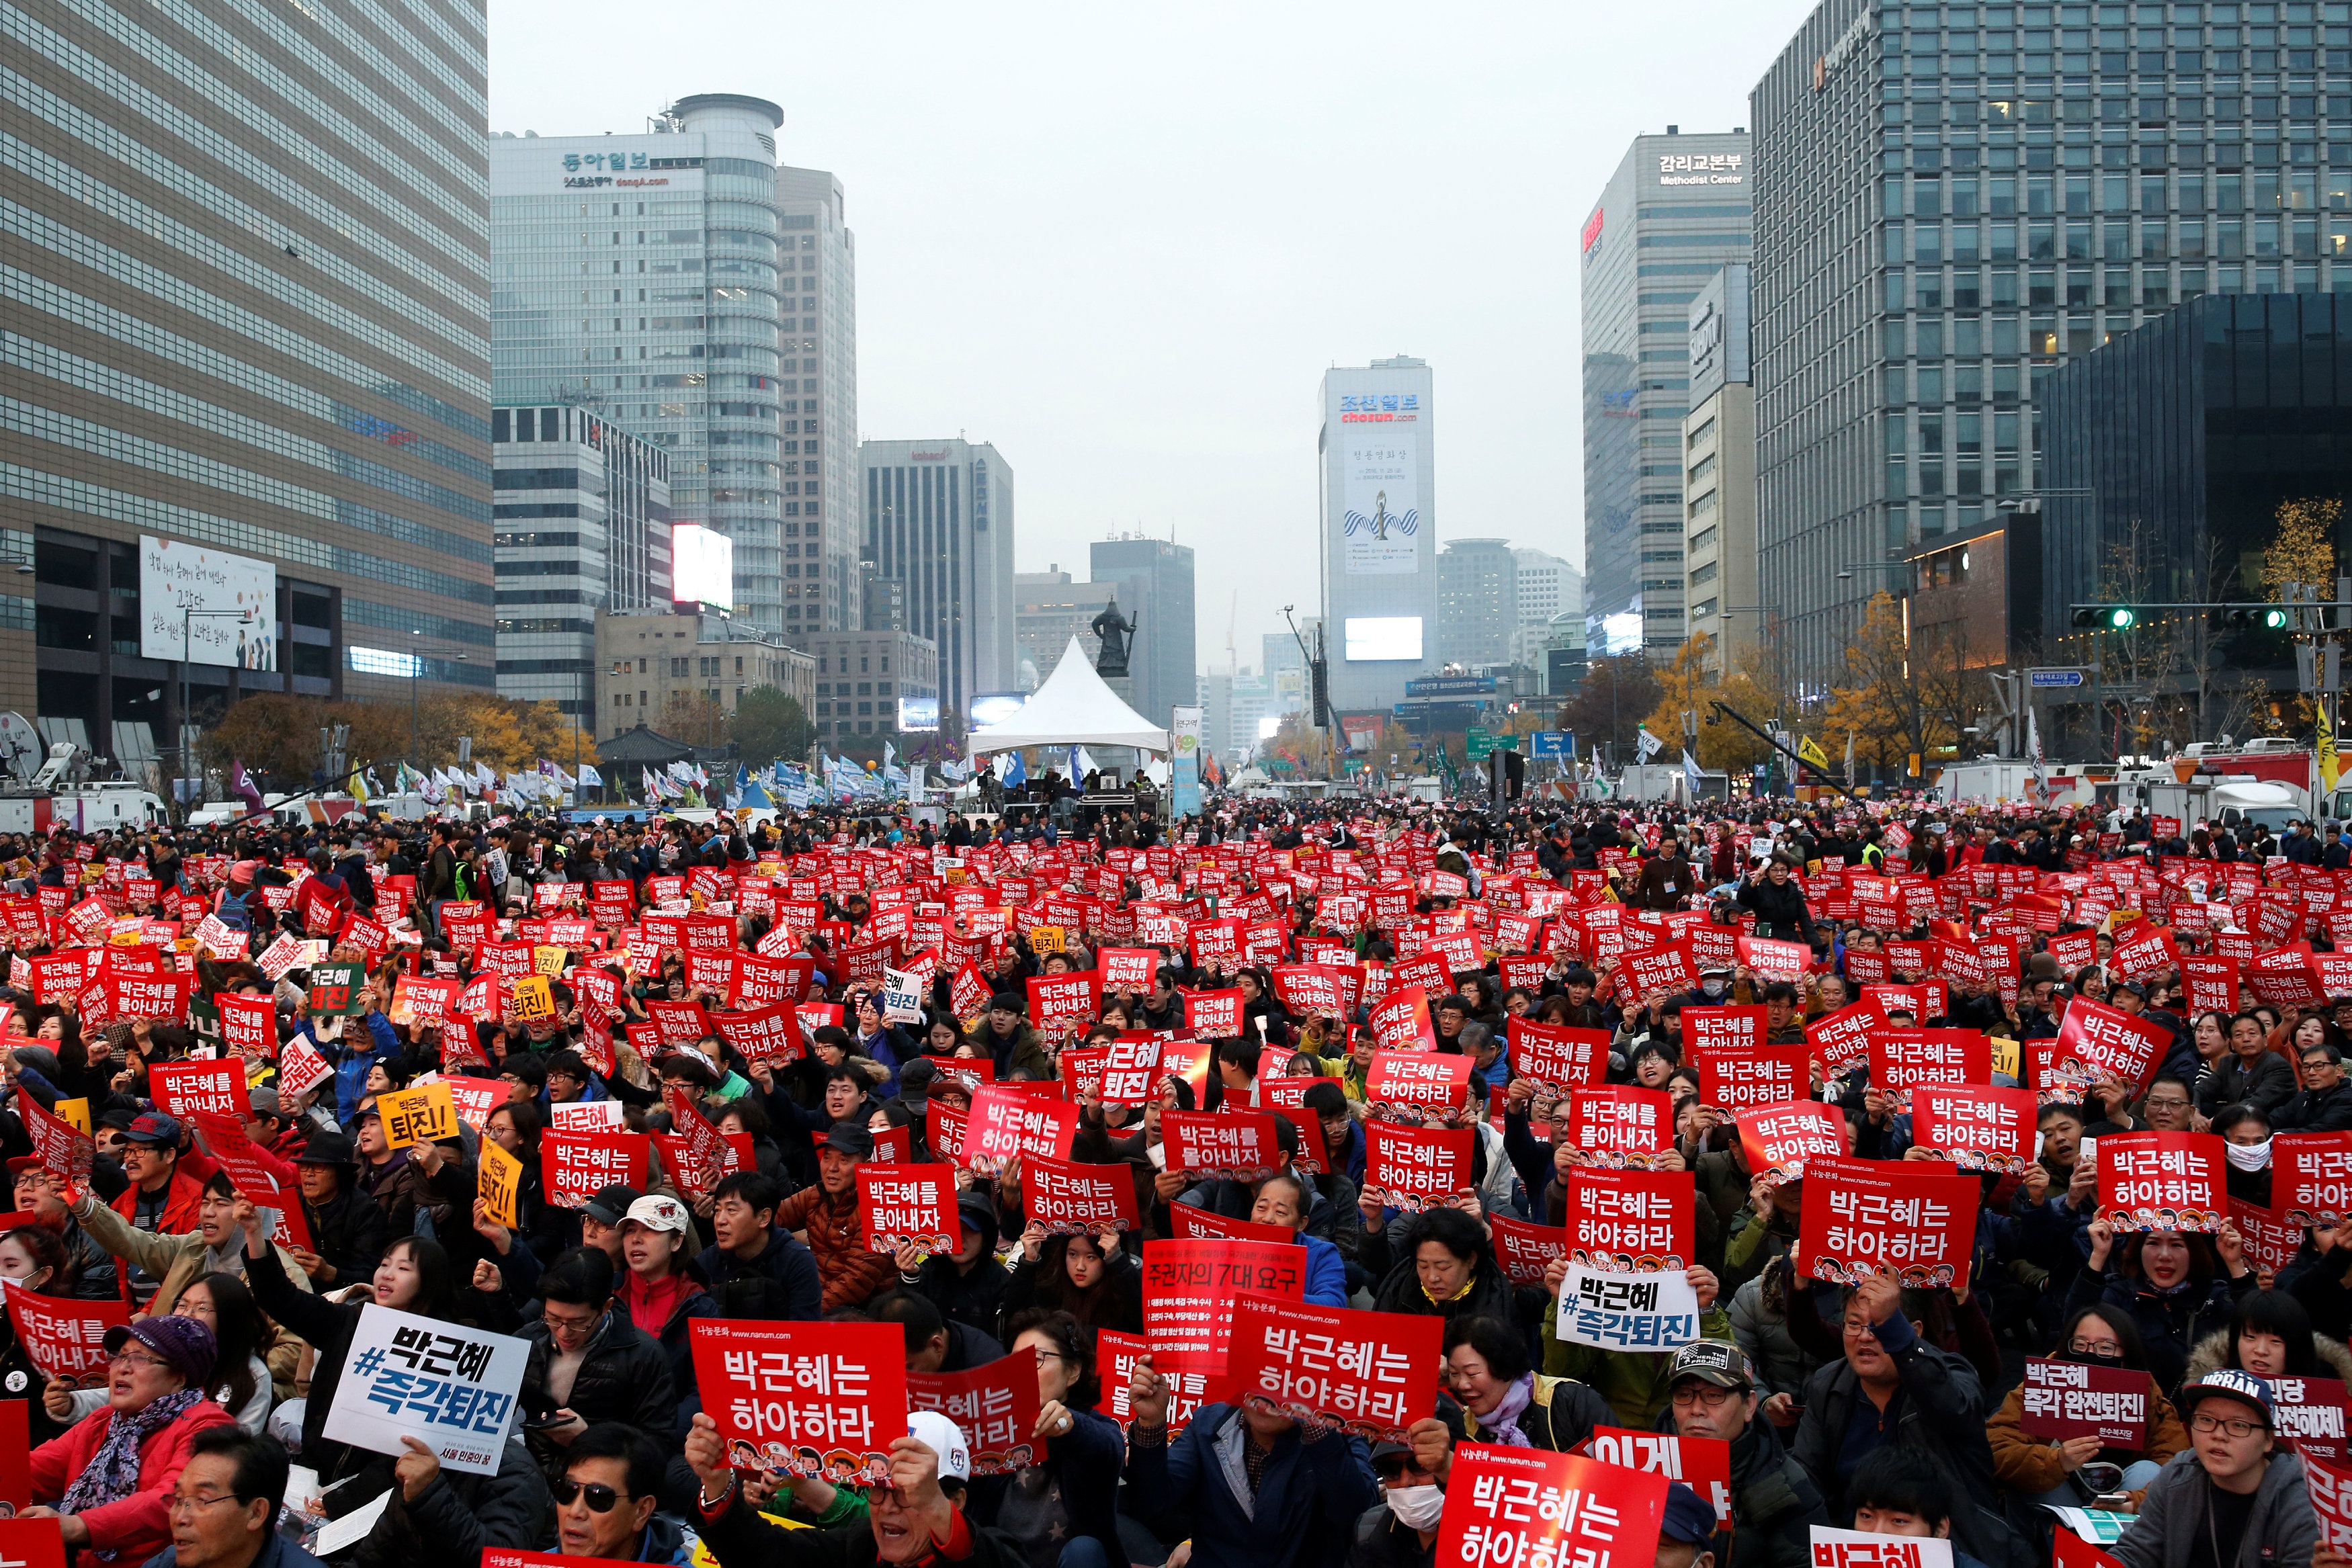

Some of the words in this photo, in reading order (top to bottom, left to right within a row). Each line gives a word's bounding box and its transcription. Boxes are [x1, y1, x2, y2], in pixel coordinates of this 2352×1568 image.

[562, 152, 648, 171] 동아일보
[1659, 155, 1742, 173] 감리교본부
[616, 177, 669, 187] dongA.com
[1660, 175, 1708, 185] Methodist
[1710, 175, 1742, 185] Center
[1339, 394, 1420, 412] 조선일보
[1341, 412, 1417, 423] chosun.com
[176, 589, 205, 611] 고맙다
[263, 887, 292, 898] 박근혜
[267, 896, 286, 908] 퇴진
[536, 884, 563, 896] 박근혜
[2302, 891, 2335, 903] 박근혜
[2308, 903, 2330, 912] 퇴진
[349, 928, 380, 948] 몰아내자
[353, 920, 384, 939] 박근혜를
[1035, 938, 1060, 953] 퇴진!
[1889, 947, 1921, 957] 박근혜는
[1108, 956, 1149, 969] 박근혜를
[1890, 957, 1922, 967] 하야하라
[312, 967, 351, 986] 박근혜
[1106, 968, 1147, 982] 몰아내자
[310, 986, 350, 1010] 퇴진
[2192, 980, 2228, 995] 박근혜를
[513, 995, 548, 1017] 퇴진!
[2193, 994, 2229, 1010] 몰아내자
[721, 1014, 785, 1040] 박근혜를
[1885, 1042, 1964, 1064] 박근혜는
[1717, 1059, 1793, 1080] 박근혜는
[1886, 1066, 1966, 1086] 하야하라
[1104, 1071, 1149, 1098] 퇴진
[1717, 1082, 1794, 1104] 하야하라
[400, 1094, 429, 1108] 박근혜
[1582, 1100, 1656, 1125] 박근혜를
[1931, 1098, 2018, 1126] 박근혜는
[390, 1105, 446, 1142] 퇴진!
[1757, 1115, 1836, 1138] 박근혜는
[1179, 1125, 1259, 1147] 박근혜를
[1580, 1125, 1658, 1150] 몰아내자
[1931, 1123, 2019, 1152] 하야하라
[556, 1144, 632, 1171] 박근혜는
[1182, 1145, 1261, 1167] 몰아내자
[1378, 1137, 1456, 1167] 박근혜는
[1764, 1137, 1841, 1162] 하야하라
[490, 1156, 507, 1181] 박근혜
[2113, 1150, 2209, 1177] 박근혜는
[555, 1168, 630, 1192] 하야하라
[1034, 1168, 1114, 1199] 박근혜는
[1378, 1163, 1456, 1192] 하야하라
[1810, 1169, 1839, 1181] 나눔문화
[1840, 1176, 1892, 1187] www.nanum.com
[480, 1170, 511, 1223] 퇴진!
[1579, 1186, 1673, 1219] 박근혜는
[2115, 1180, 2212, 1207] 하야하라
[1034, 1194, 1118, 1219] 하야하라
[1830, 1190, 1950, 1227] 박근혜는
[1578, 1219, 1674, 1252] 하야하라
[1826, 1225, 1948, 1262] 하야하라
[1148, 1262, 1212, 1287] 주권자의
[1218, 1264, 1253, 1289] 7대
[1256, 1267, 1297, 1292] 요구
[1199, 1298, 1212, 1307] 수사
[1579, 1276, 1659, 1313] 박근혜
[1242, 1299, 1277, 1315] 나눔문화
[1278, 1309, 1340, 1325] www.nanum.com
[1562, 1293, 1693, 1348] #즉각퇴진
[19, 1305, 107, 1344] 박근혜를
[697, 1325, 730, 1337] 나눔문화
[732, 1330, 791, 1340] www.nanum.com
[389, 1325, 495, 1384] 박근혜
[1264, 1325, 1411, 1384] 박근혜는
[1696, 1355, 1726, 1363] HEROES
[724, 1350, 870, 1396] 박근혜는
[1114, 1352, 1208, 1396] 박혜를
[2026, 1363, 2088, 1389] 박근혜
[2201, 1372, 2260, 1398] URBAN
[353, 1346, 513, 1436] #즉각퇴진
[1259, 1364, 1407, 1426] 하야하라
[2023, 1387, 2062, 1418] 즉각
[2064, 1390, 2144, 1423] 완전퇴진!
[730, 1399, 874, 1447] 하야하라
[2099, 1427, 2133, 1438] 환수복지당
[439, 1448, 458, 1460] 서울
[458, 1450, 483, 1464] 민중의
[481, 1454, 491, 1465] 꿈
[1460, 1448, 1490, 1463] 나눔문화
[1490, 1454, 1547, 1469] www.nanum.com
[1594, 1435, 1683, 1481] 이게
[1472, 1474, 1620, 1542] 박근혜는
[1461, 1525, 1611, 1568] 하야하라
